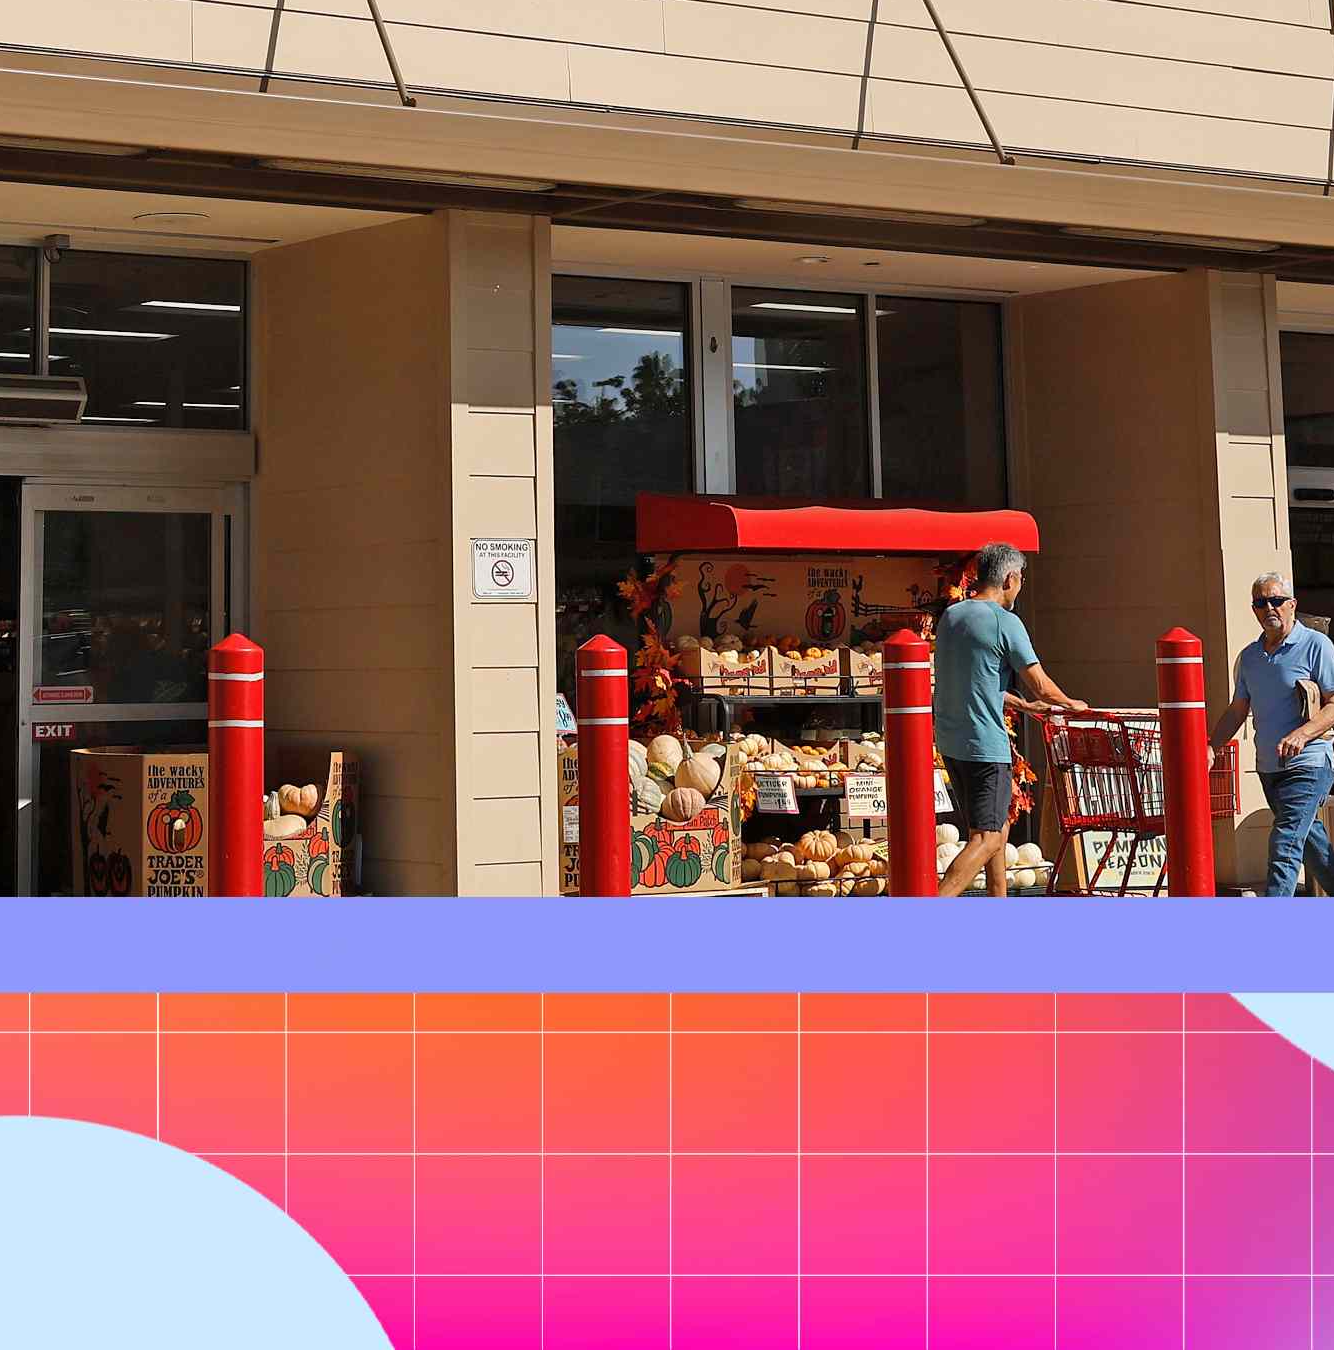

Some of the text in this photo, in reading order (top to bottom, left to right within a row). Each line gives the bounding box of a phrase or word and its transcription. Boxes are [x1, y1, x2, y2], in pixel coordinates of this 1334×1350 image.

[475, 543, 528, 551] NO SMOKING
[35, 725, 73, 738] EXIT
[148, 764, 204, 779] the wacky
[147, 778, 205, 789] ADVENTURES
[1093, 837, 1167, 854] PMKIN
[147, 856, 204, 868] TRADER
[1097, 854, 1162, 868] EAON
[147, 885, 204, 897] PUMPKIN
